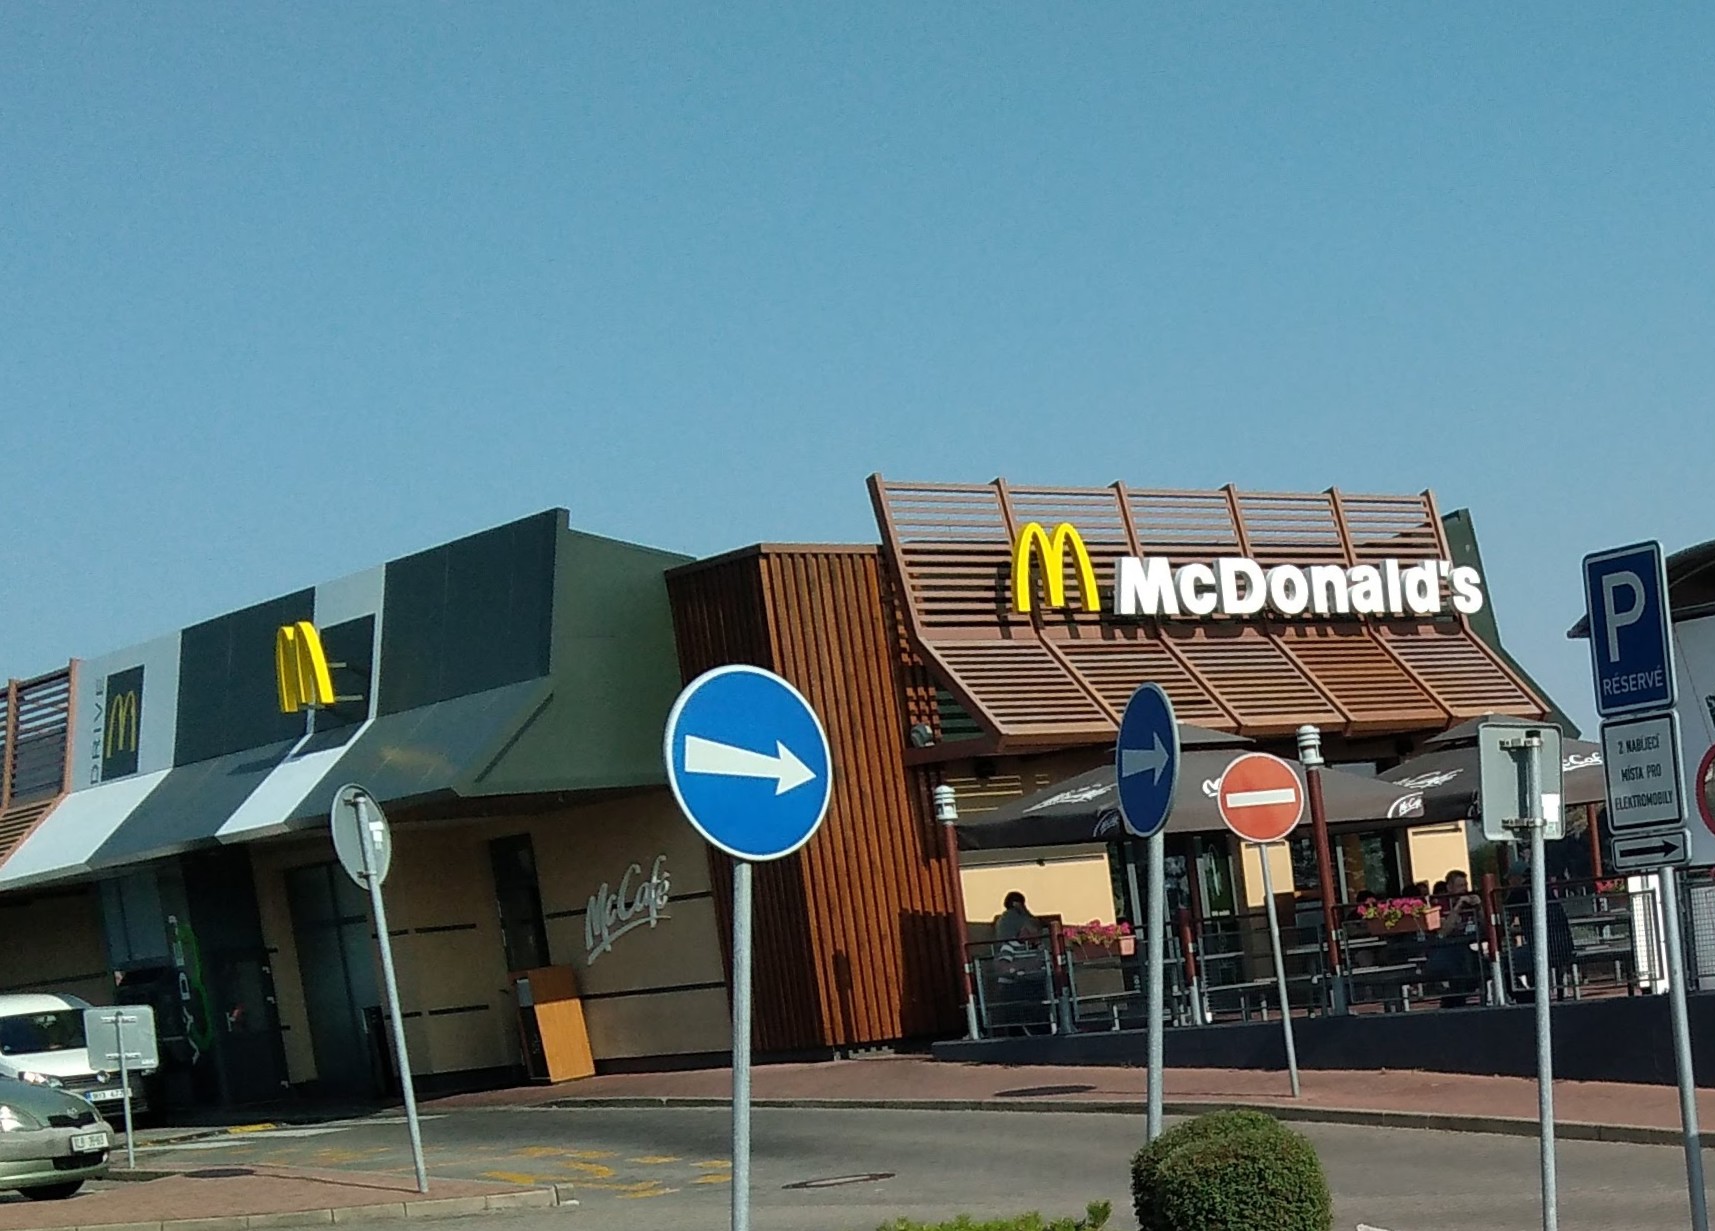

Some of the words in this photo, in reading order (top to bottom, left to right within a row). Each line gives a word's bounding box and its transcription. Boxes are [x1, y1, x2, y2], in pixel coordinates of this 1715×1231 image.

[1114, 556, 1484, 615] McDonald's
[1601, 570, 1646, 663] P
[1602, 665, 1664, 696] RÉSERVÉ
[1617, 740, 1624, 755] 2
[1621, 764, 1645, 782] MÍSTA
[1646, 763, 1662, 778] PRO
[1614, 790, 1674, 811] ELEKTROMOBILY
[585, 853, 671, 962] McCafé
